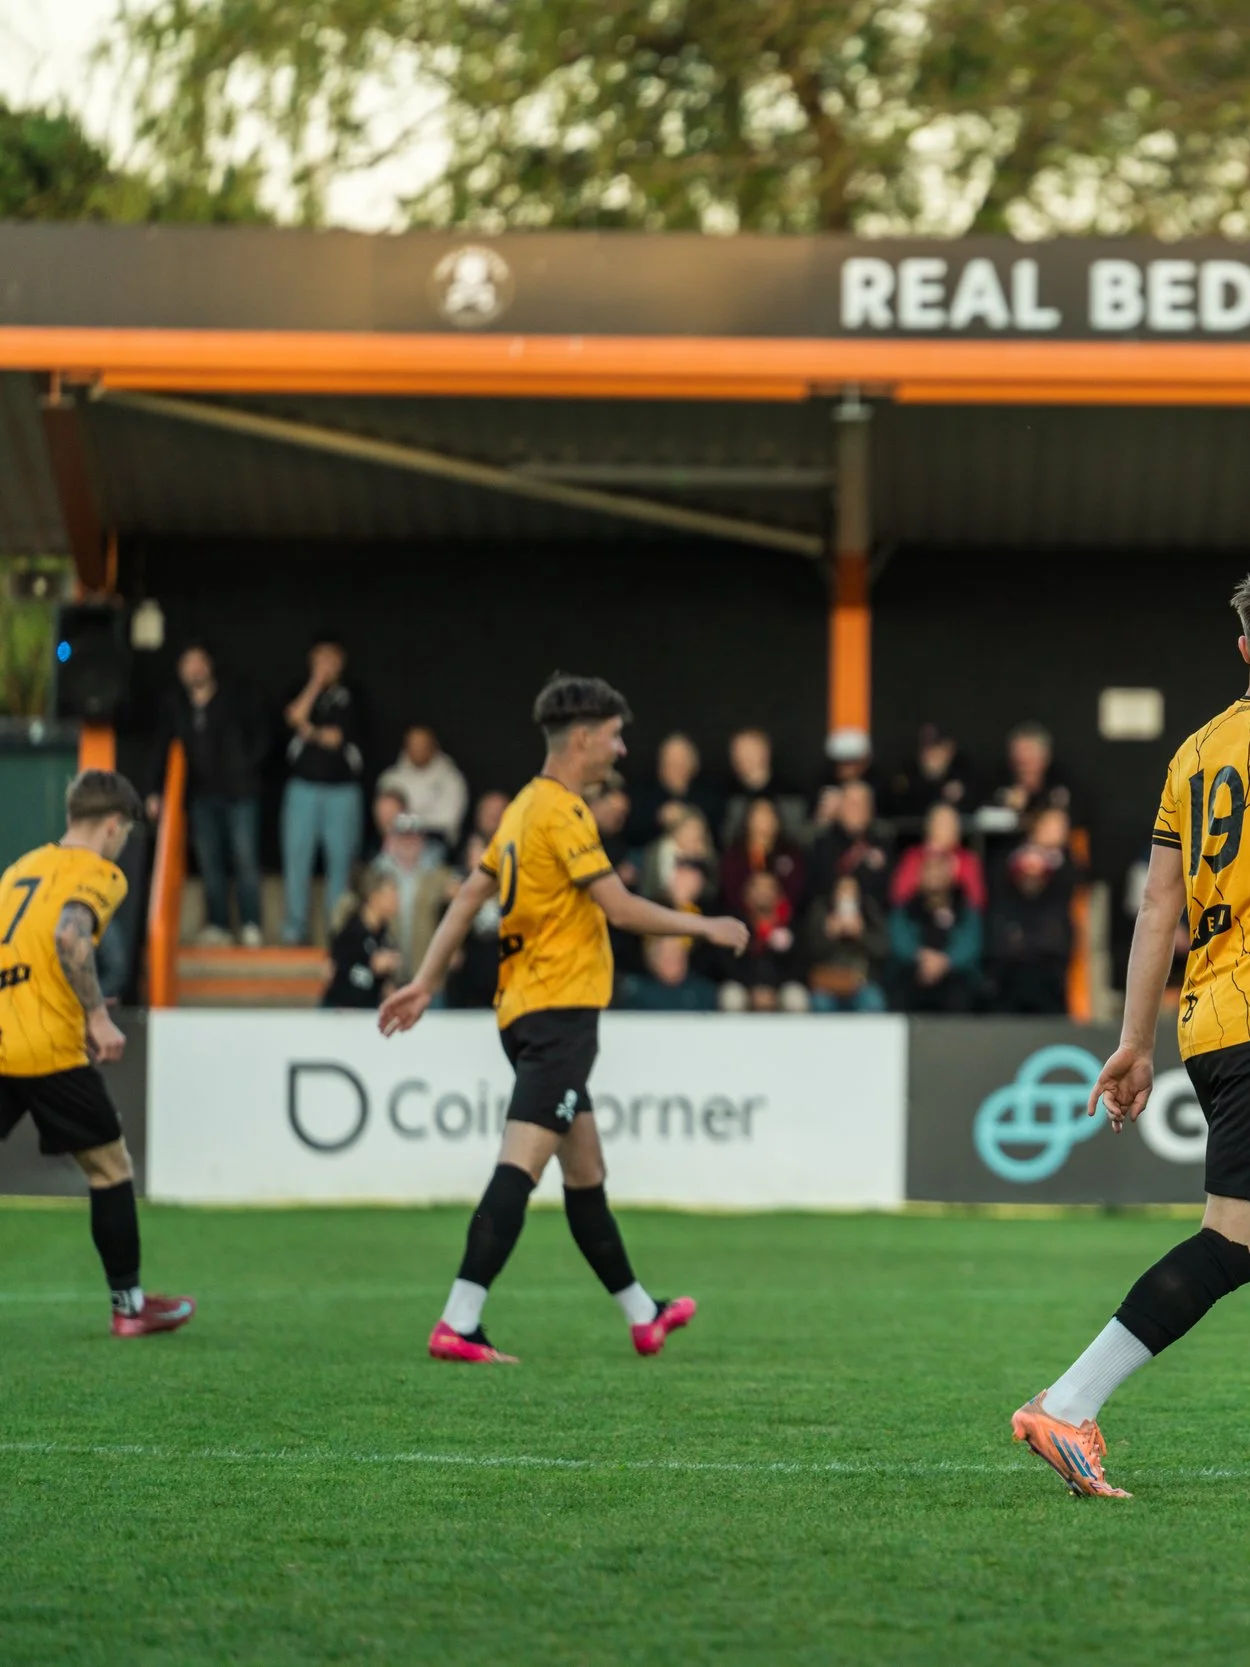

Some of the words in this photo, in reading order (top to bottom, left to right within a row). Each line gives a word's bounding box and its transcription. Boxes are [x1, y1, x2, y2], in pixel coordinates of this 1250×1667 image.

[840, 258, 1062, 331] REAL
[1188, 765, 1244, 875] 19
[2, 877, 42, 944] 7
[389, 1078, 768, 1142] Coiorner
